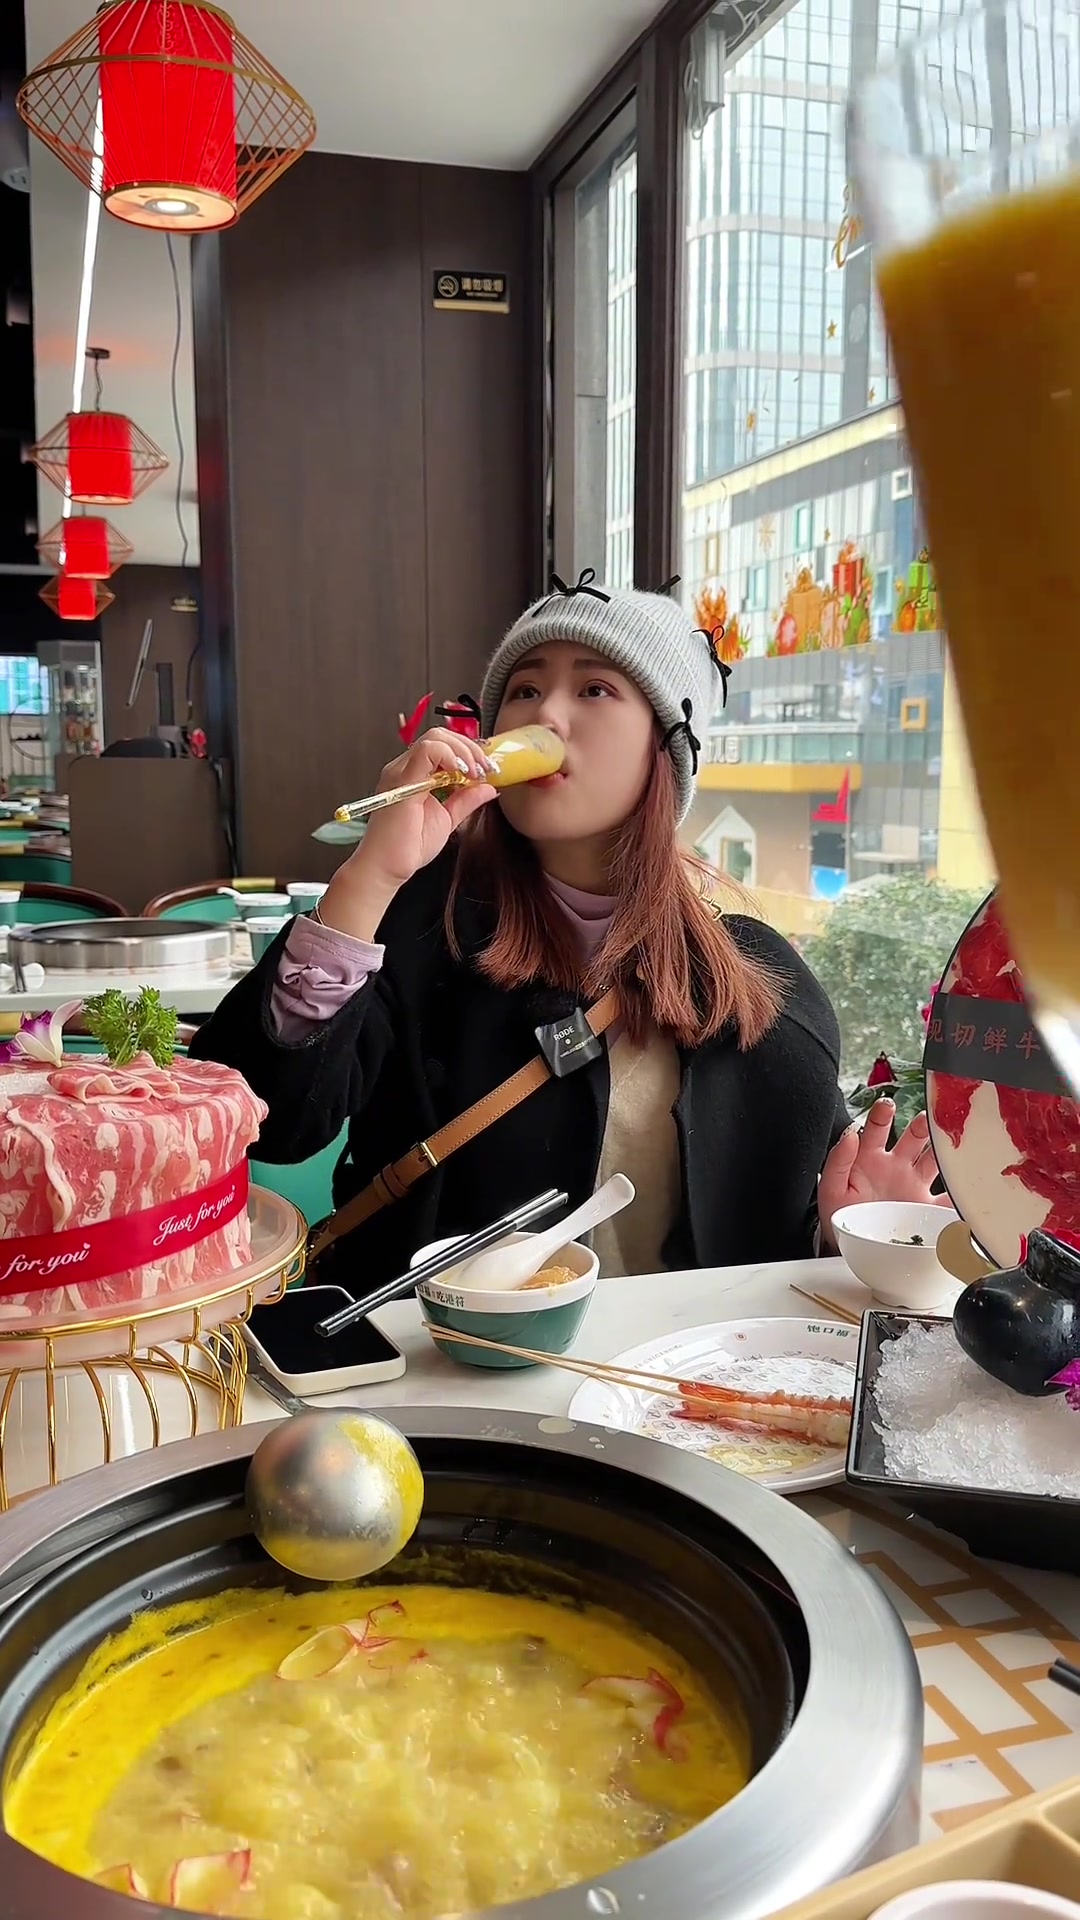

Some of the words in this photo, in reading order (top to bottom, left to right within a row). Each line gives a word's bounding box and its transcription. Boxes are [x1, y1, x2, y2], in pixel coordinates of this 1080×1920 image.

[152, 1215, 193, 1246] Just
[187, 1202, 215, 1232] for
[213, 1188, 235, 1219] you
[0, 1254, 43, 1280] for
[38, 1246, 91, 1275] you
